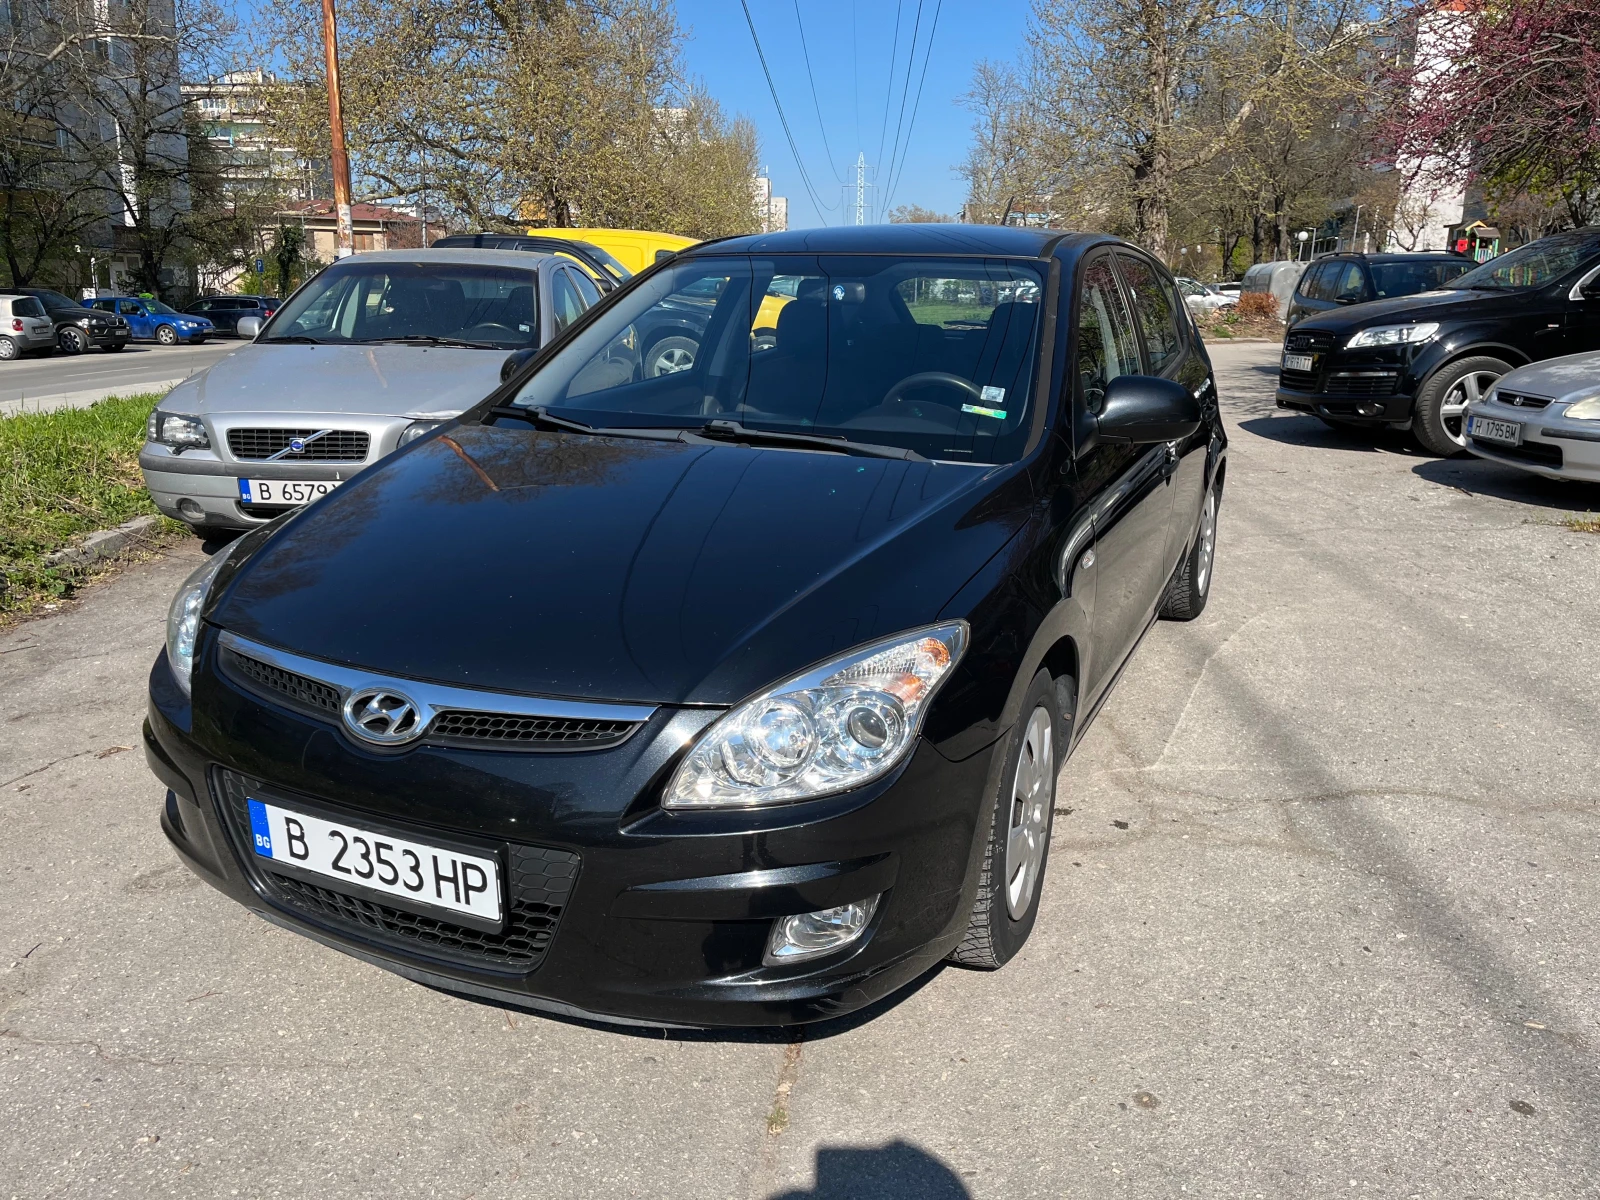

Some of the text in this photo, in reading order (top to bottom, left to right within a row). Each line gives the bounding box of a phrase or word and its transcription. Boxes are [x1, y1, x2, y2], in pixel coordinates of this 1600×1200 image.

[259, 482, 272, 500] B
[255, 833, 271, 848] BG
[284, 816, 310, 861] B
